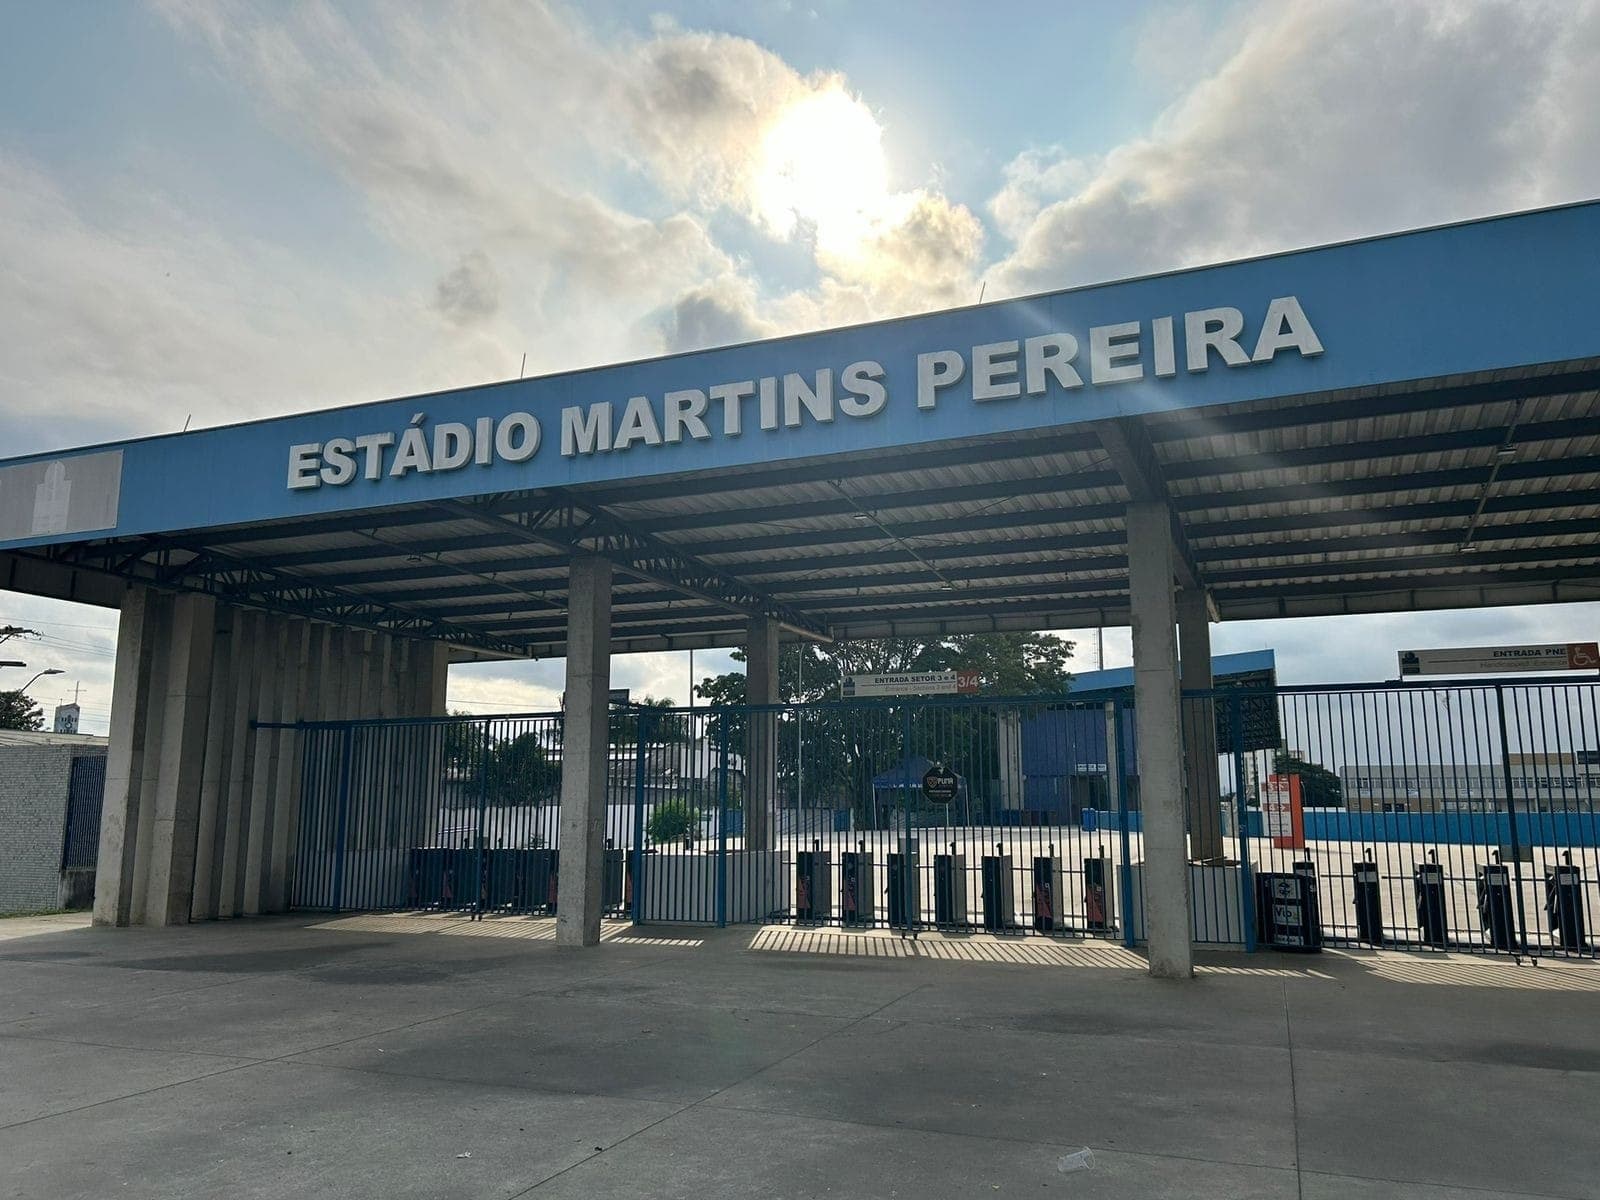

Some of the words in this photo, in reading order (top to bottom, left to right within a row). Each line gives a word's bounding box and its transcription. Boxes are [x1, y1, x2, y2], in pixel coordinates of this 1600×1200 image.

[286, 412, 542, 490] ESTÁDIO
[560, 360, 888, 457] MARTINS
[916, 295, 1326, 410] PEREIRA
[1493, 649, 1541, 657] ENTRADA
[1545, 648, 1566, 656] PNE
[874, 676, 909, 684] ENTRADA
[958, 676, 979, 687] 3/4
